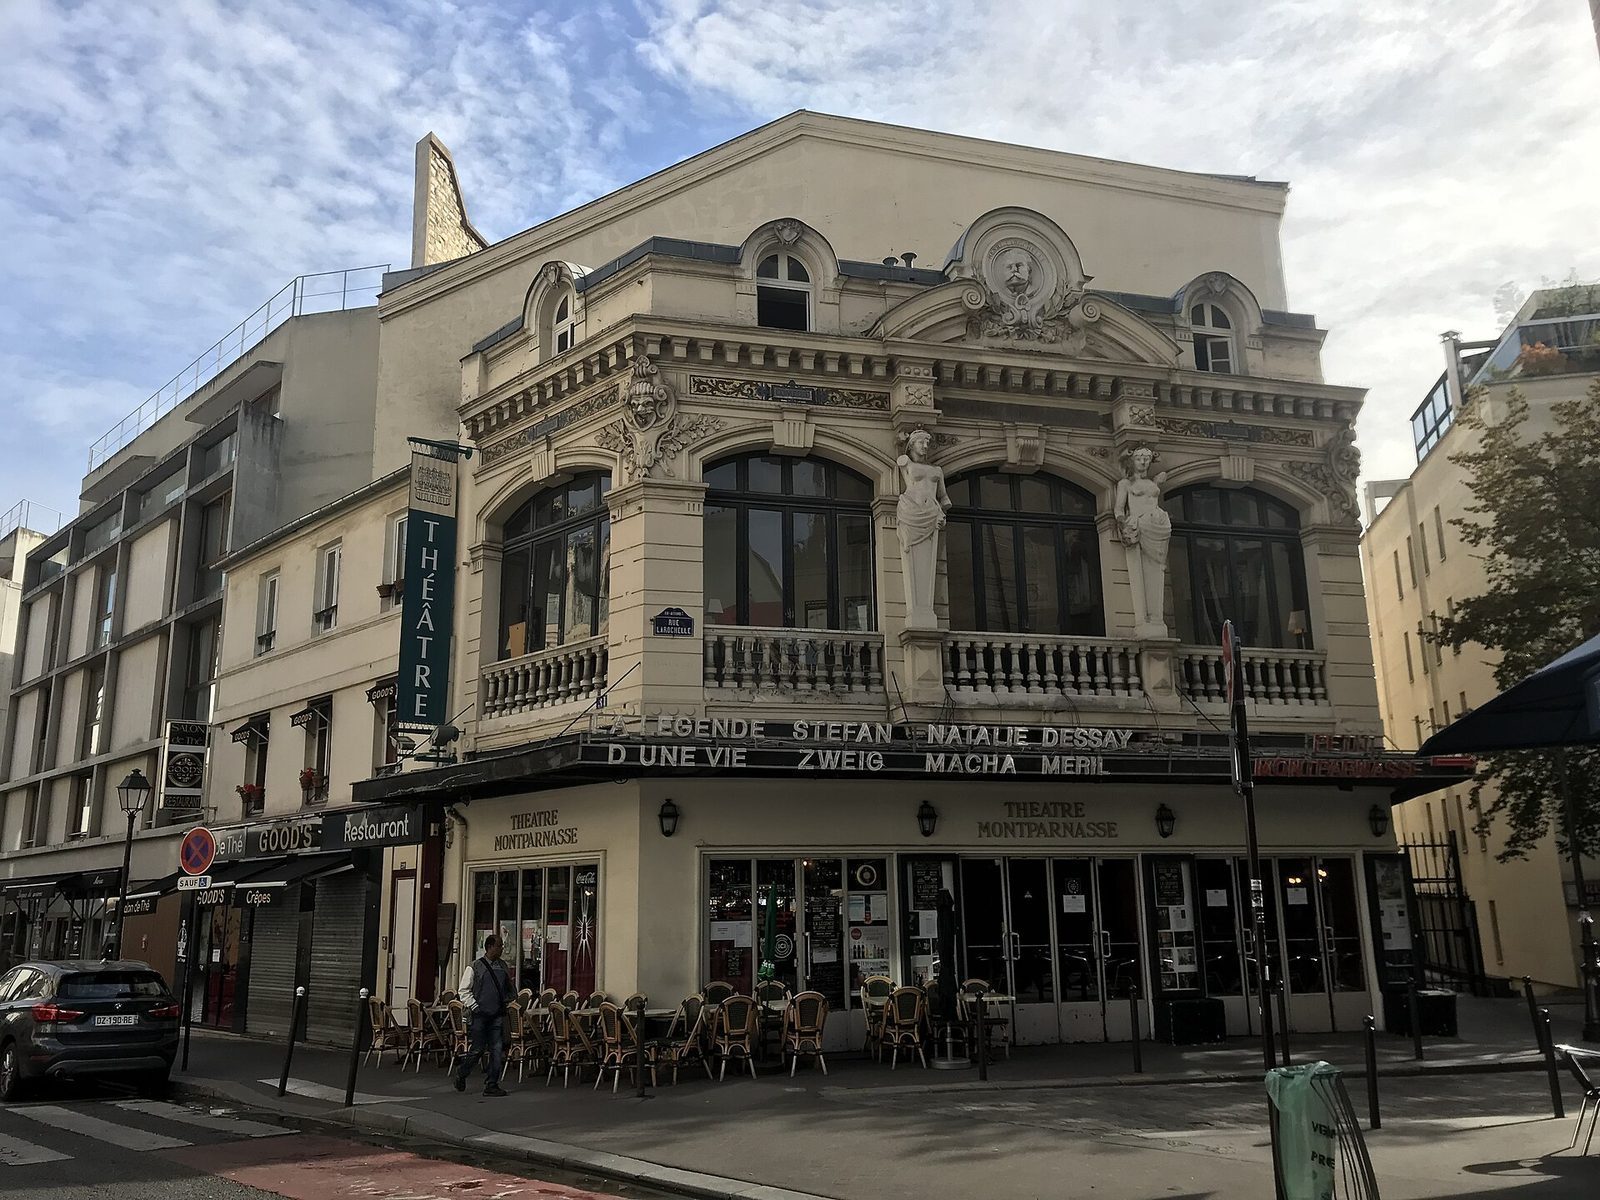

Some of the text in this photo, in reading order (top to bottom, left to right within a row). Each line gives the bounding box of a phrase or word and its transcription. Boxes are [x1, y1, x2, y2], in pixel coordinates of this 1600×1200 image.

[414, 519, 440, 717] THÉÂTRE
[591, 714, 1133, 749] LA LEGENDE STEFAN NATALIE DESSAY
[608, 744, 1111, 776] D UNE VIE ZWEIG MACHA MERIL
[510, 809, 559, 831] THEATRE
[1003, 801, 1086, 818] THEATRE
[259, 823, 313, 852] GOOD'S
[344, 812, 409, 843] Restaurant
[976, 821, 1119, 838] MONTPARNASSE
[227, 835, 243, 854] Thé
[494, 828, 579, 852] MONTPARNASSE
[179, 879, 198, 888] SAUF
[246, 889, 271, 907] Crêpes
